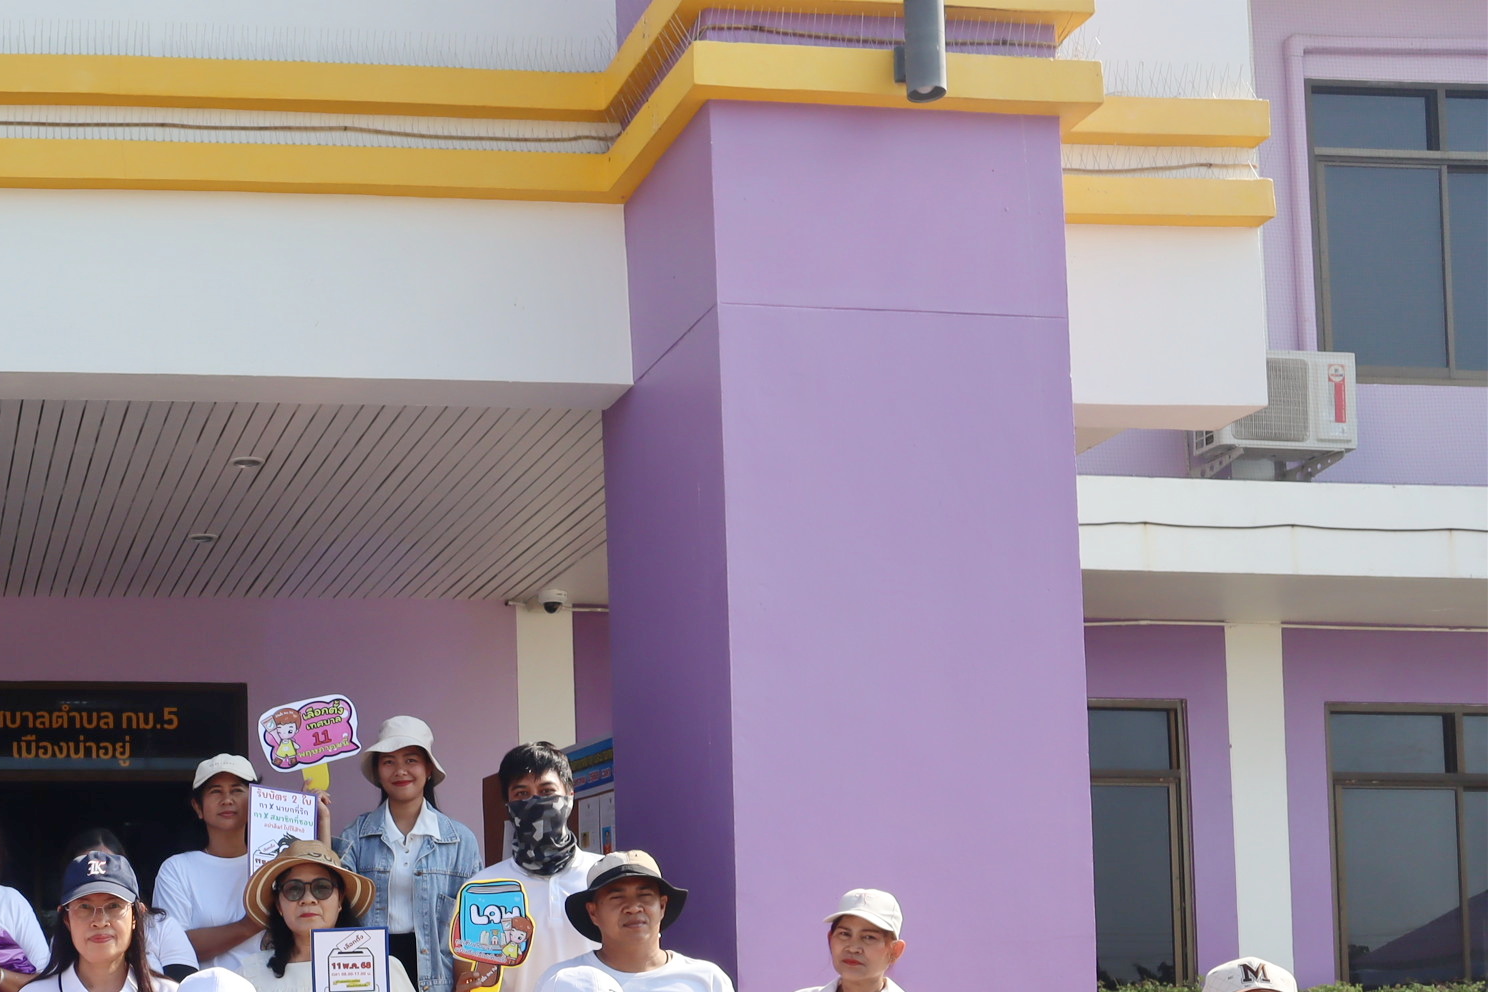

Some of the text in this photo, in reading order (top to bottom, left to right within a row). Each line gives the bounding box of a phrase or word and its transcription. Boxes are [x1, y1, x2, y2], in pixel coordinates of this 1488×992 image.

[121, 706, 179, 730] กม.5
[302, 700, 345, 720] เลือกตั้ง
[306, 716, 343, 731] เทศบาล
[313, 729, 333, 747] 11
[12, 735, 132, 767] เมืองน่าอยู่
[291, 795, 298, 804] 2
[301, 794, 312, 806] ใบ
[331, 961, 372, 970] 11 พ.ค. 68
[1239, 963, 1271, 983] M
